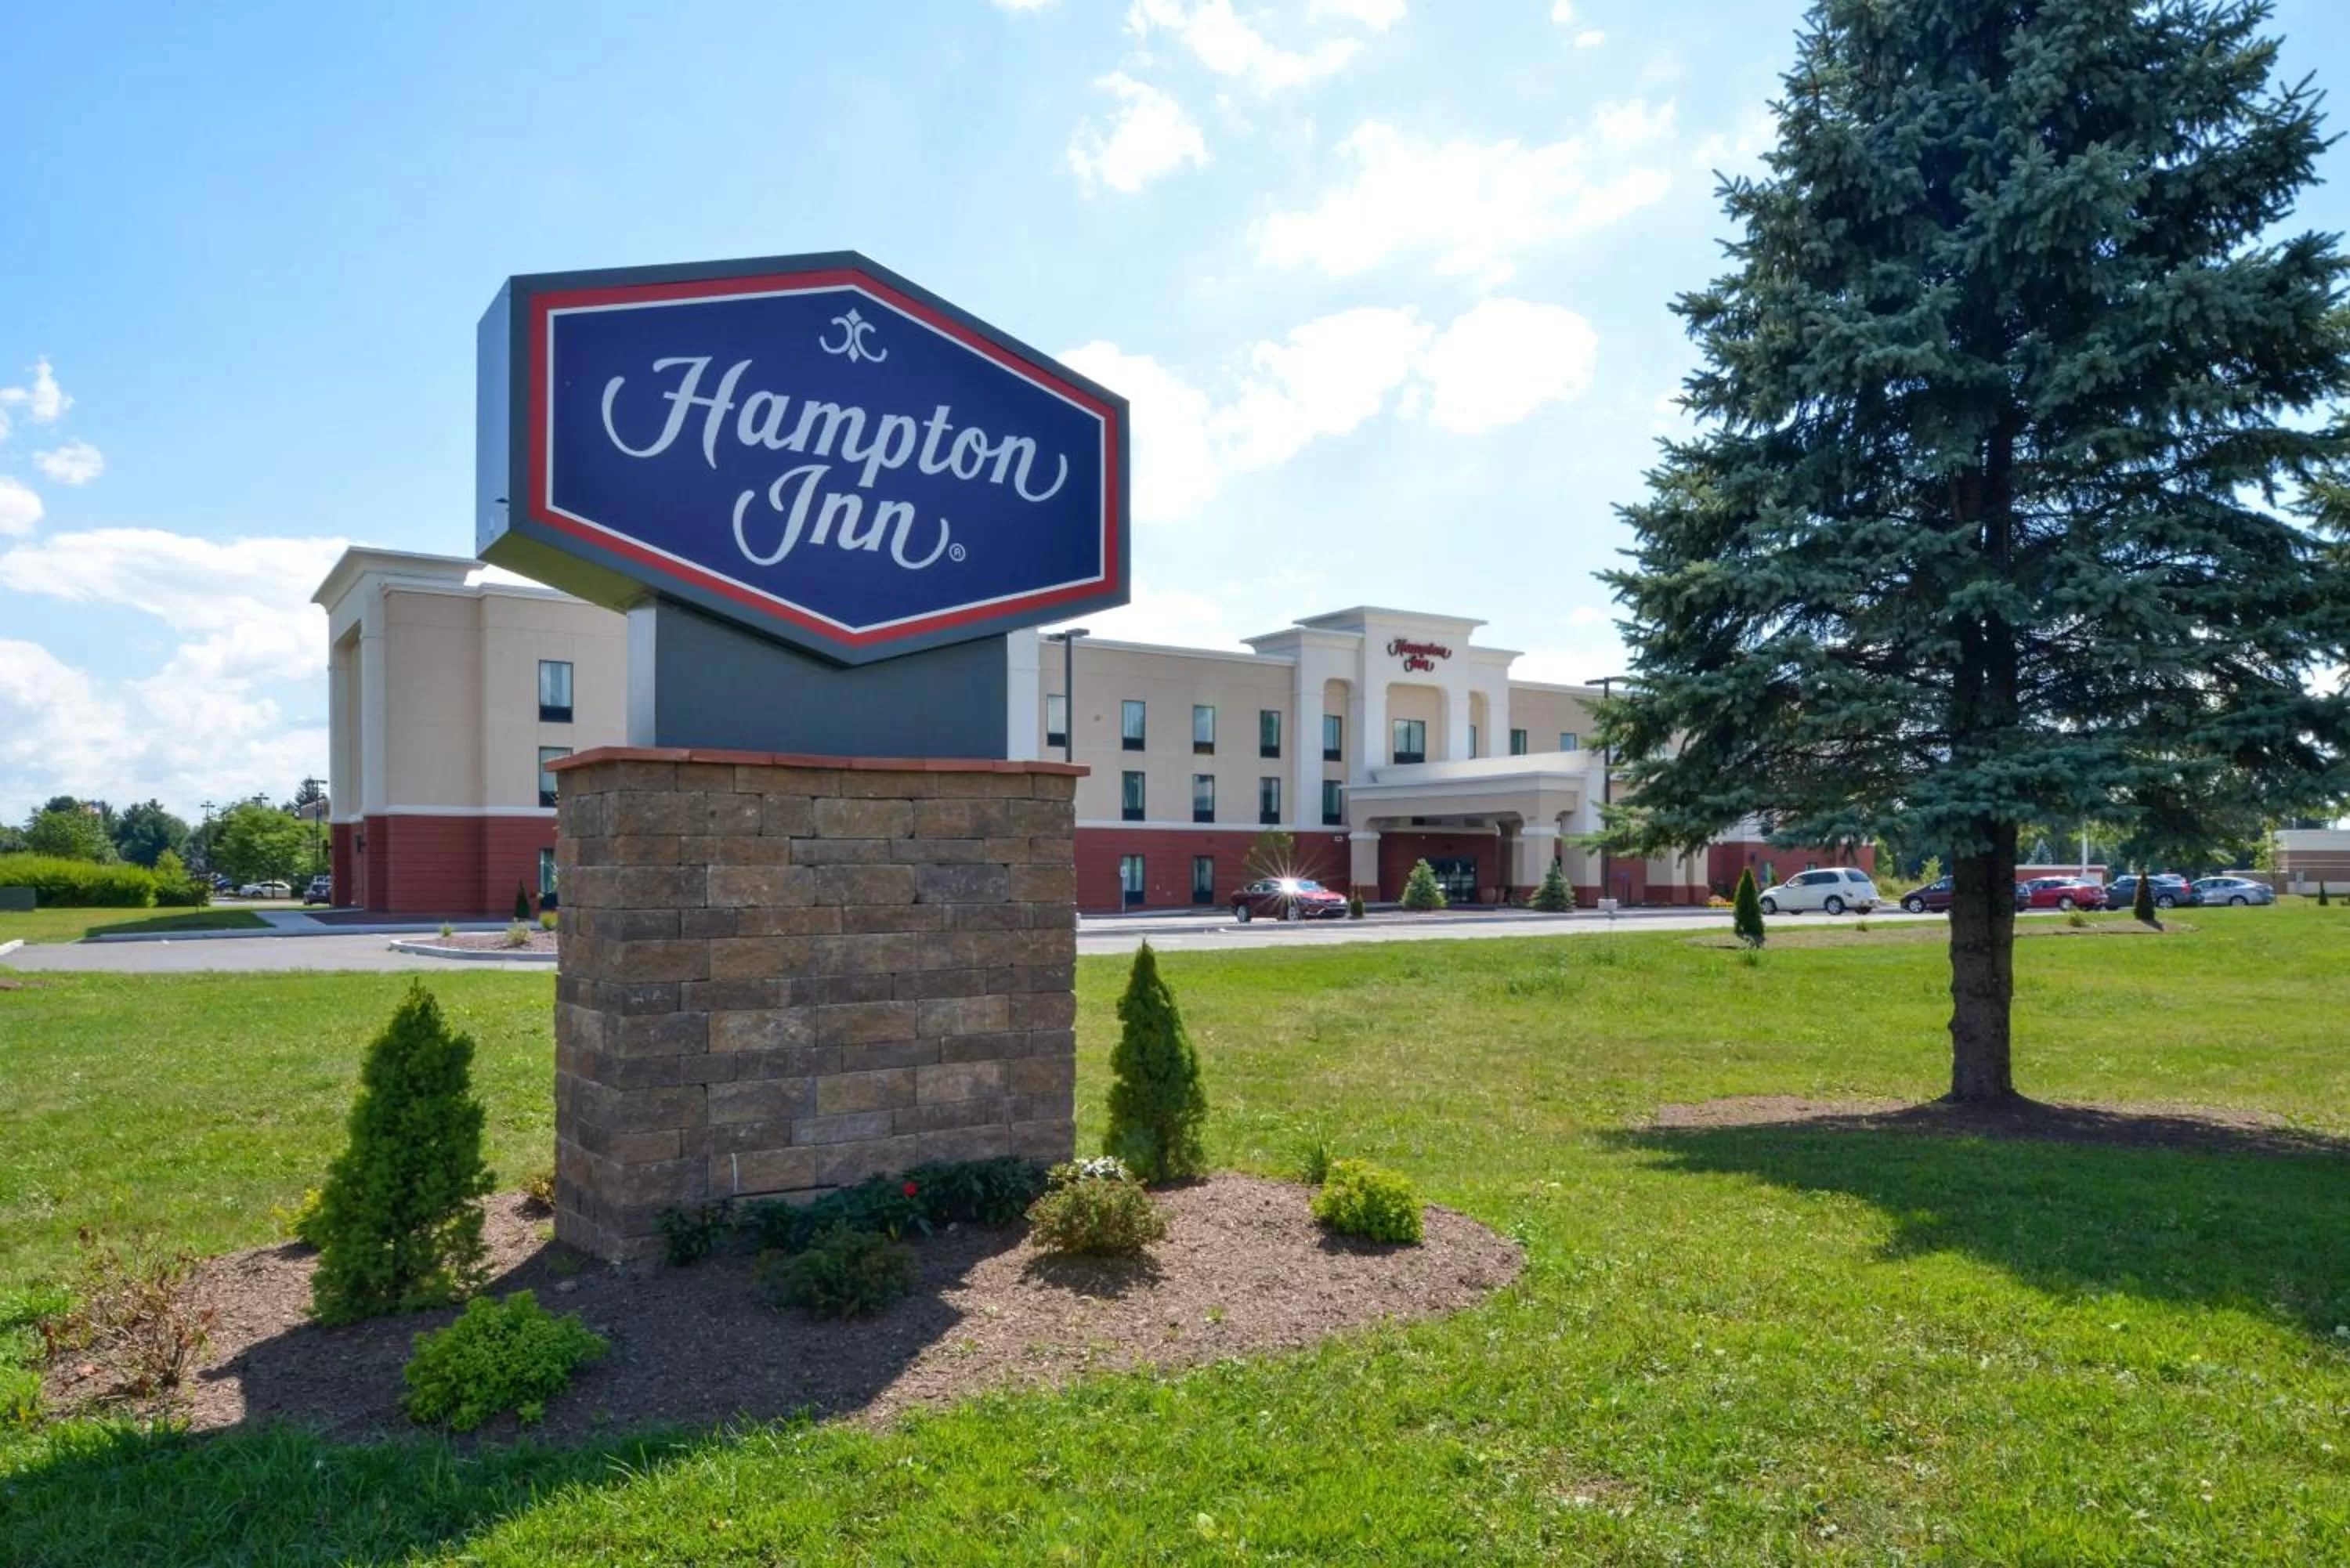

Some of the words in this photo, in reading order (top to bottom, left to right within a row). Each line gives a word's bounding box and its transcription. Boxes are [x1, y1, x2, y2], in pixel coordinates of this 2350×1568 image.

[601, 356, 1068, 502] Hampton
[1386, 638, 1452, 659] Hampton
[1404, 656, 1434, 672] Inn
